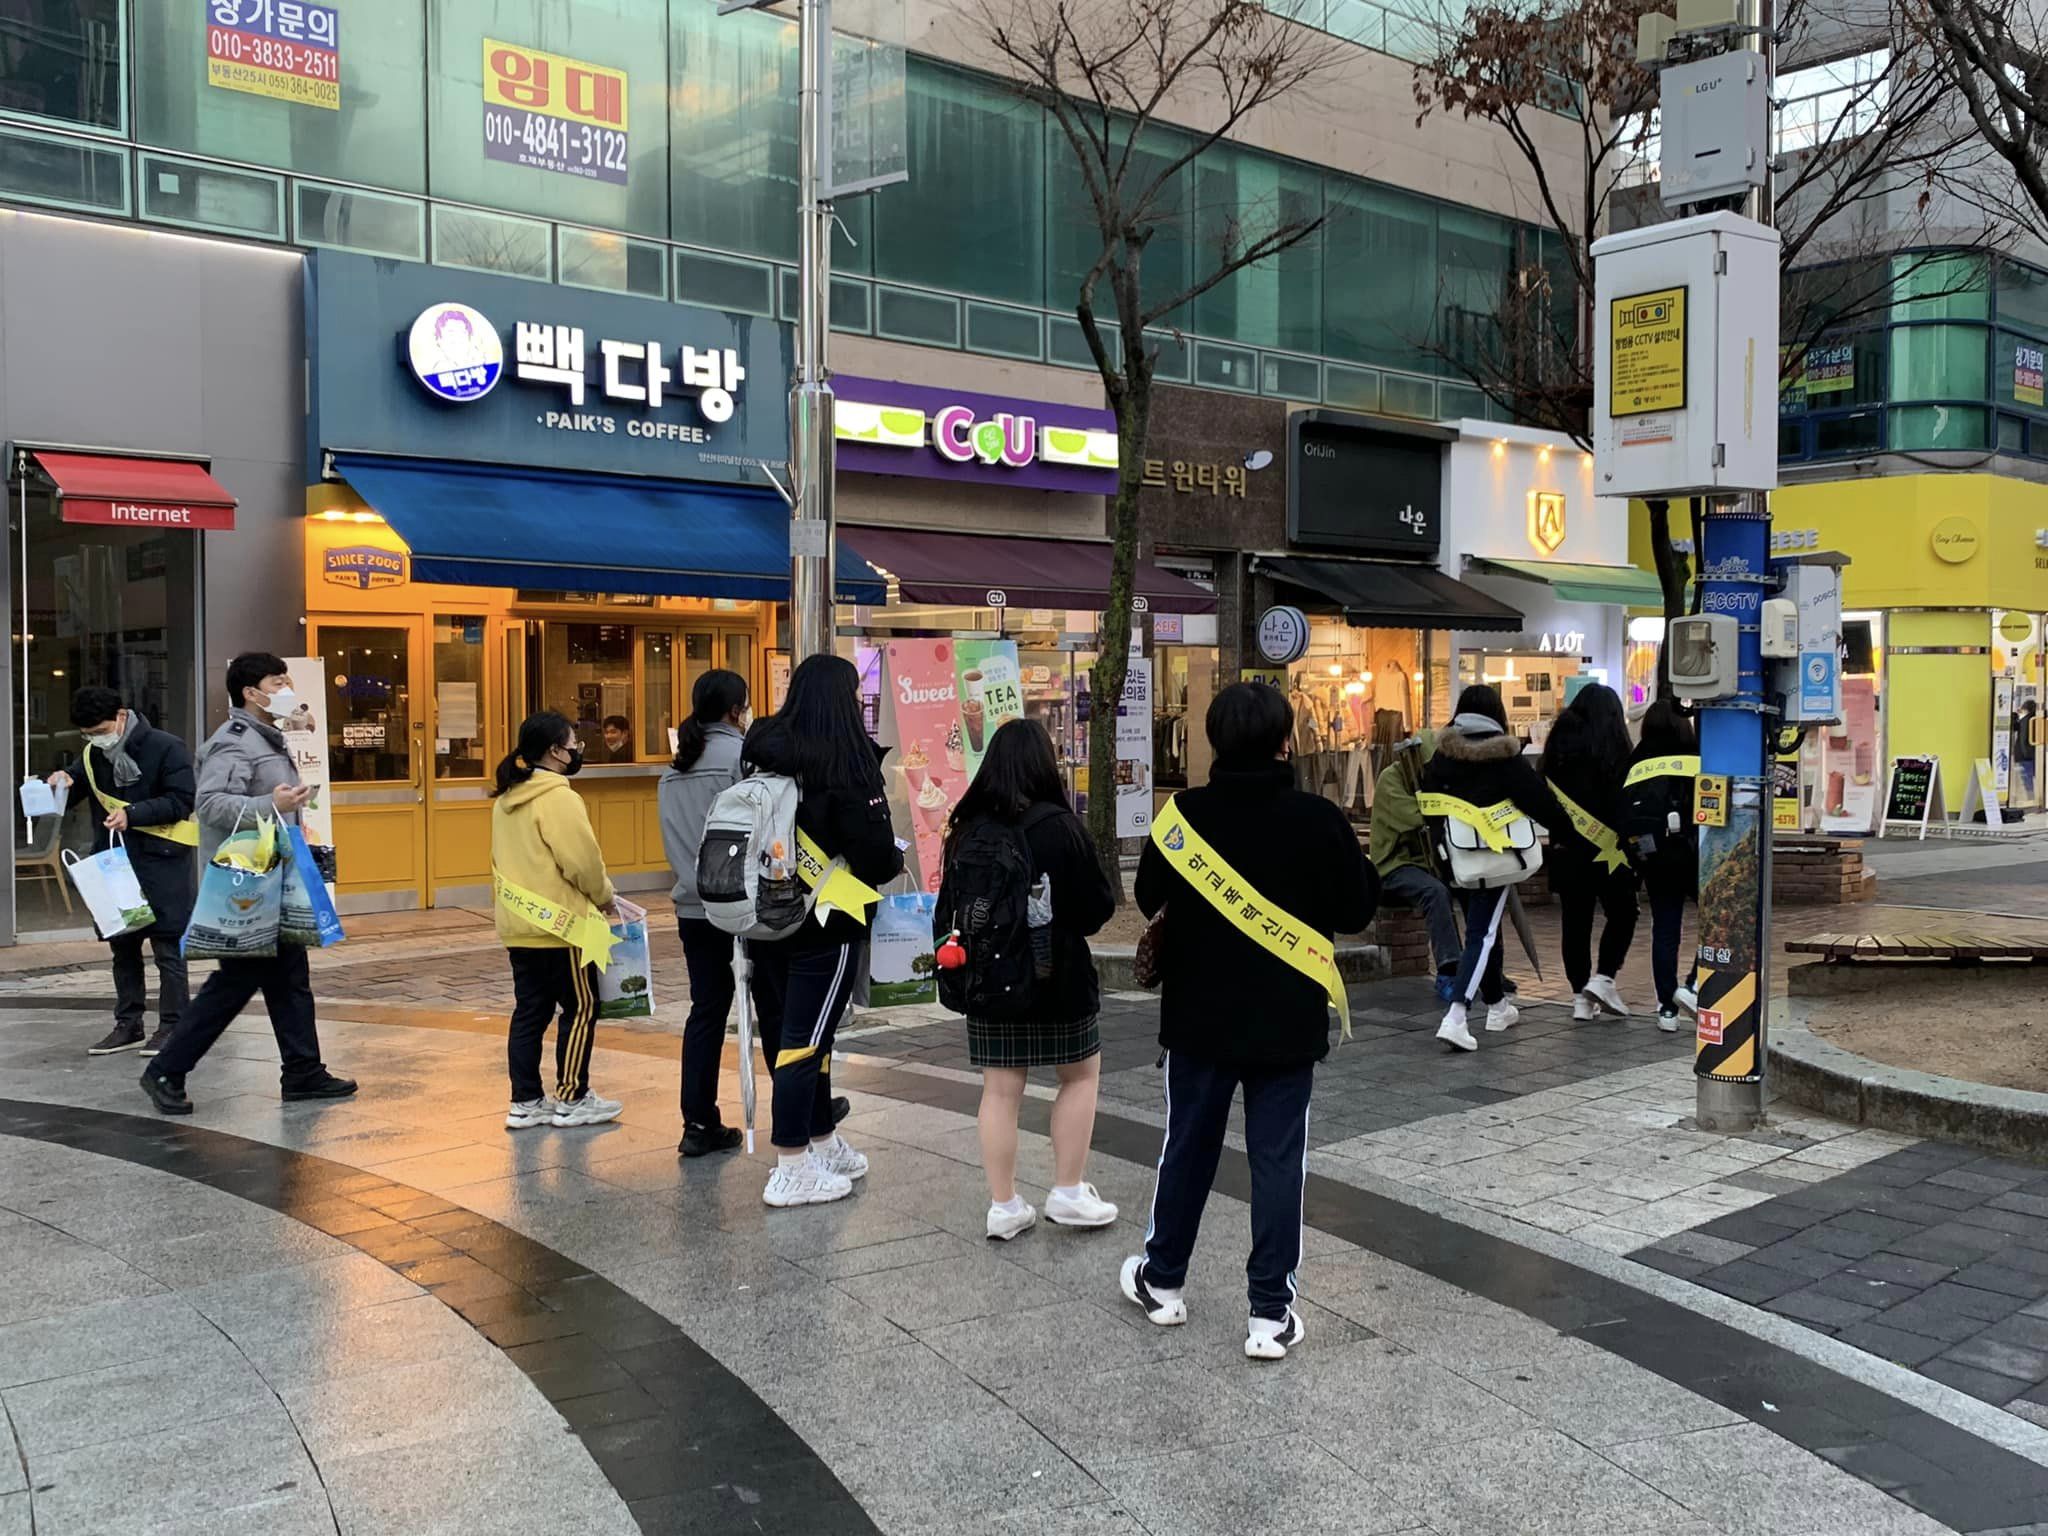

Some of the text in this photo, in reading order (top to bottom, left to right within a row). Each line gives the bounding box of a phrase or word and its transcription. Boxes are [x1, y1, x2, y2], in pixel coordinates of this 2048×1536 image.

[211, 29, 336, 79] 010-3833-2511
[485, 111, 627, 171] 010-4841-3122
[1634, 332, 1653, 346] CCTV
[515, 320, 746, 424] 빽다방
[545, 411, 704, 445] PAIK'S COFFEE
[934, 405, 1035, 468] CU
[110, 502, 191, 523] Internet
[1399, 504, 1427, 535] 나은
[327, 553, 401, 571] SINCE 2006
[988, 591, 1004, 604] CU
[1132, 598, 1146, 610] CU
[1264, 615, 1293, 643] 나은
[1538, 630, 1585, 653] A LOT
[897, 673, 957, 705] Sweet
[984, 685, 1017, 705] TEA
[988, 703, 1019, 717] series
[1187, 853, 1301, 951] 학교폭력신고
[551, 909, 571, 932] YES!
